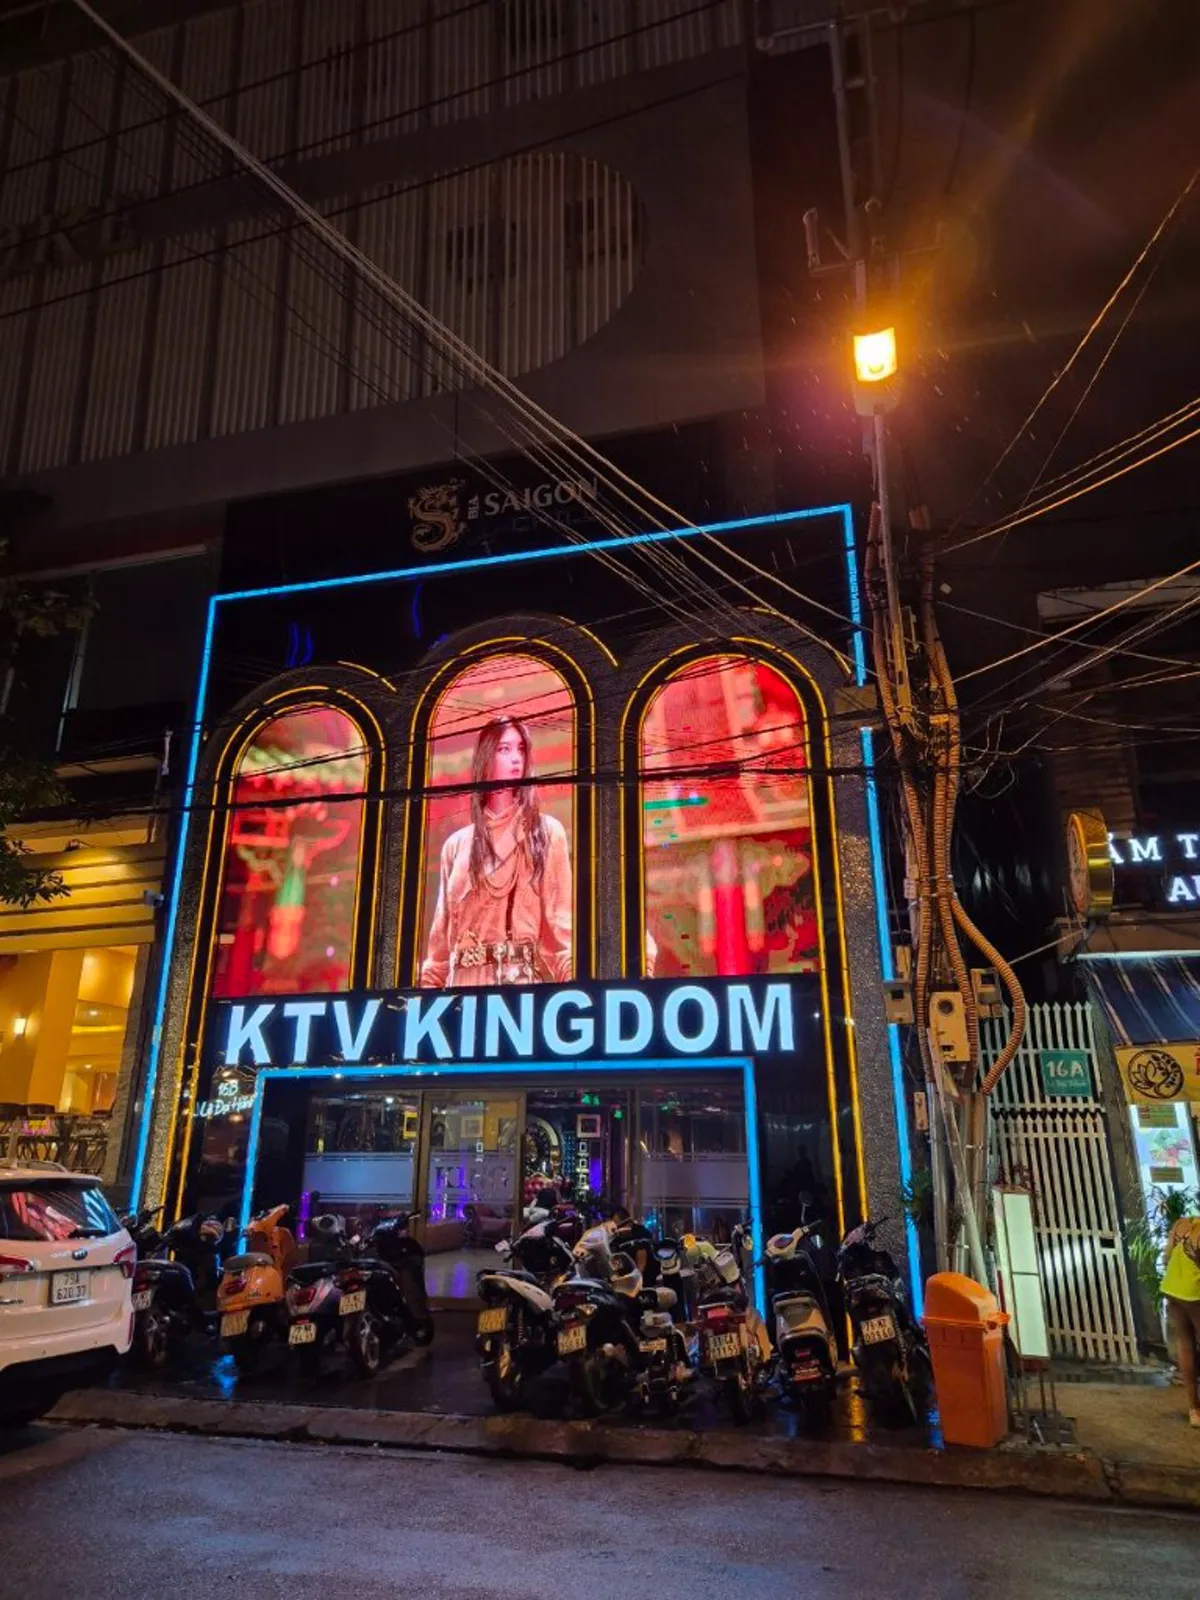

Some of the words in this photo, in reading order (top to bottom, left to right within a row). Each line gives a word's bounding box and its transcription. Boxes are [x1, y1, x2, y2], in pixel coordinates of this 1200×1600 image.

[225, 1000, 384, 1065] KTV
[403, 983, 795, 1060] KINGDOM
[1046, 1060, 1084, 1078] 16A
